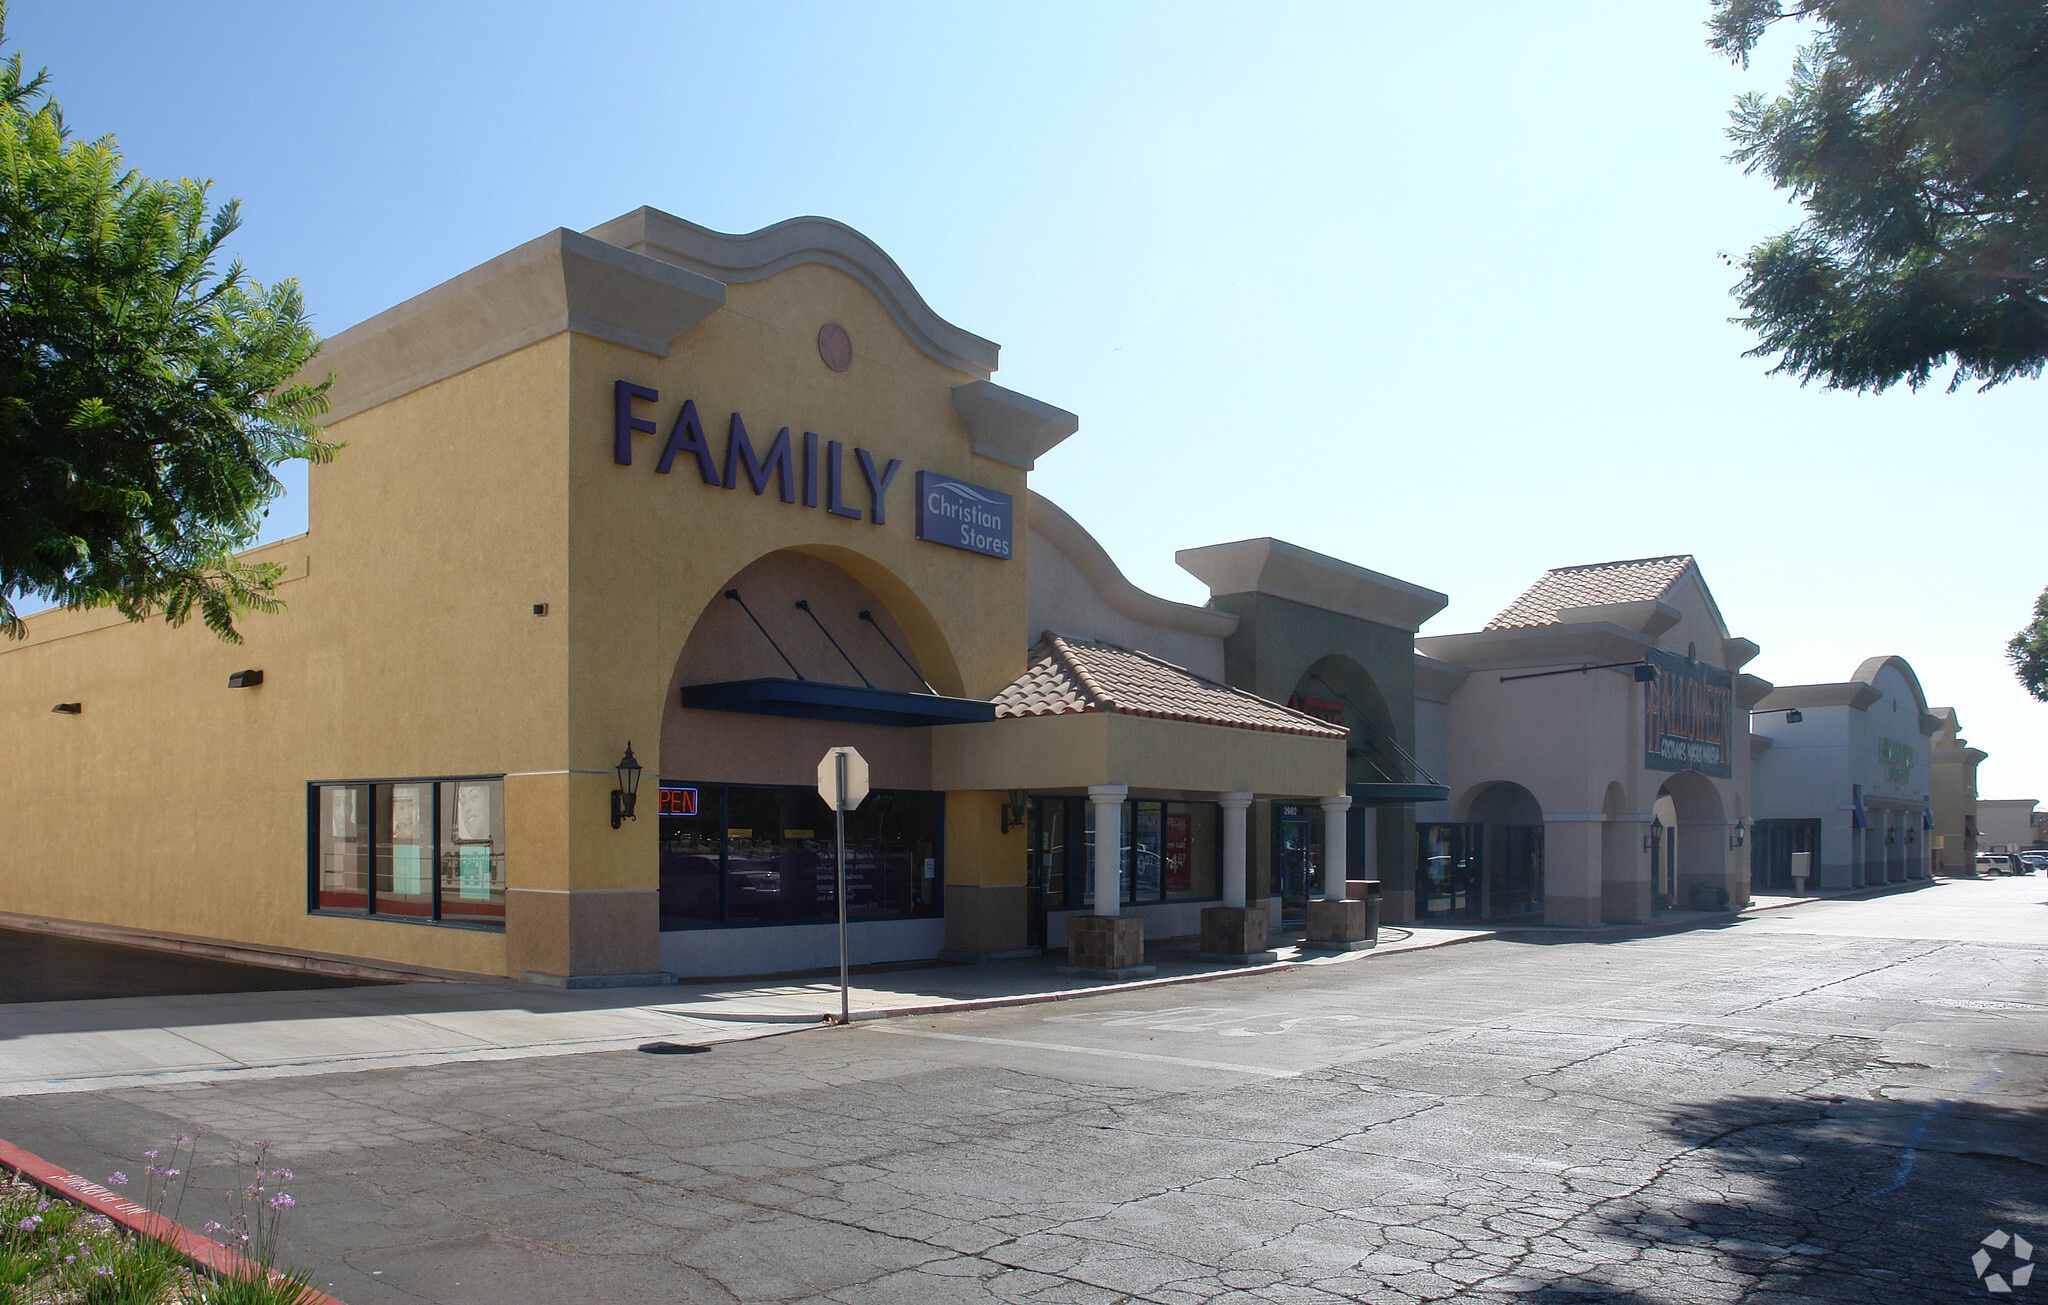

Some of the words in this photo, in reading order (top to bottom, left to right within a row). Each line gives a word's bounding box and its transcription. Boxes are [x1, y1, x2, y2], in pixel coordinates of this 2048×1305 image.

[615, 380, 901, 525] FAMILY
[928, 493, 1000, 530] Christian
[961, 524, 1009, 554] Stores
[659, 790, 695, 813] PEN
[1168, 817, 1186, 827] PECIAL
